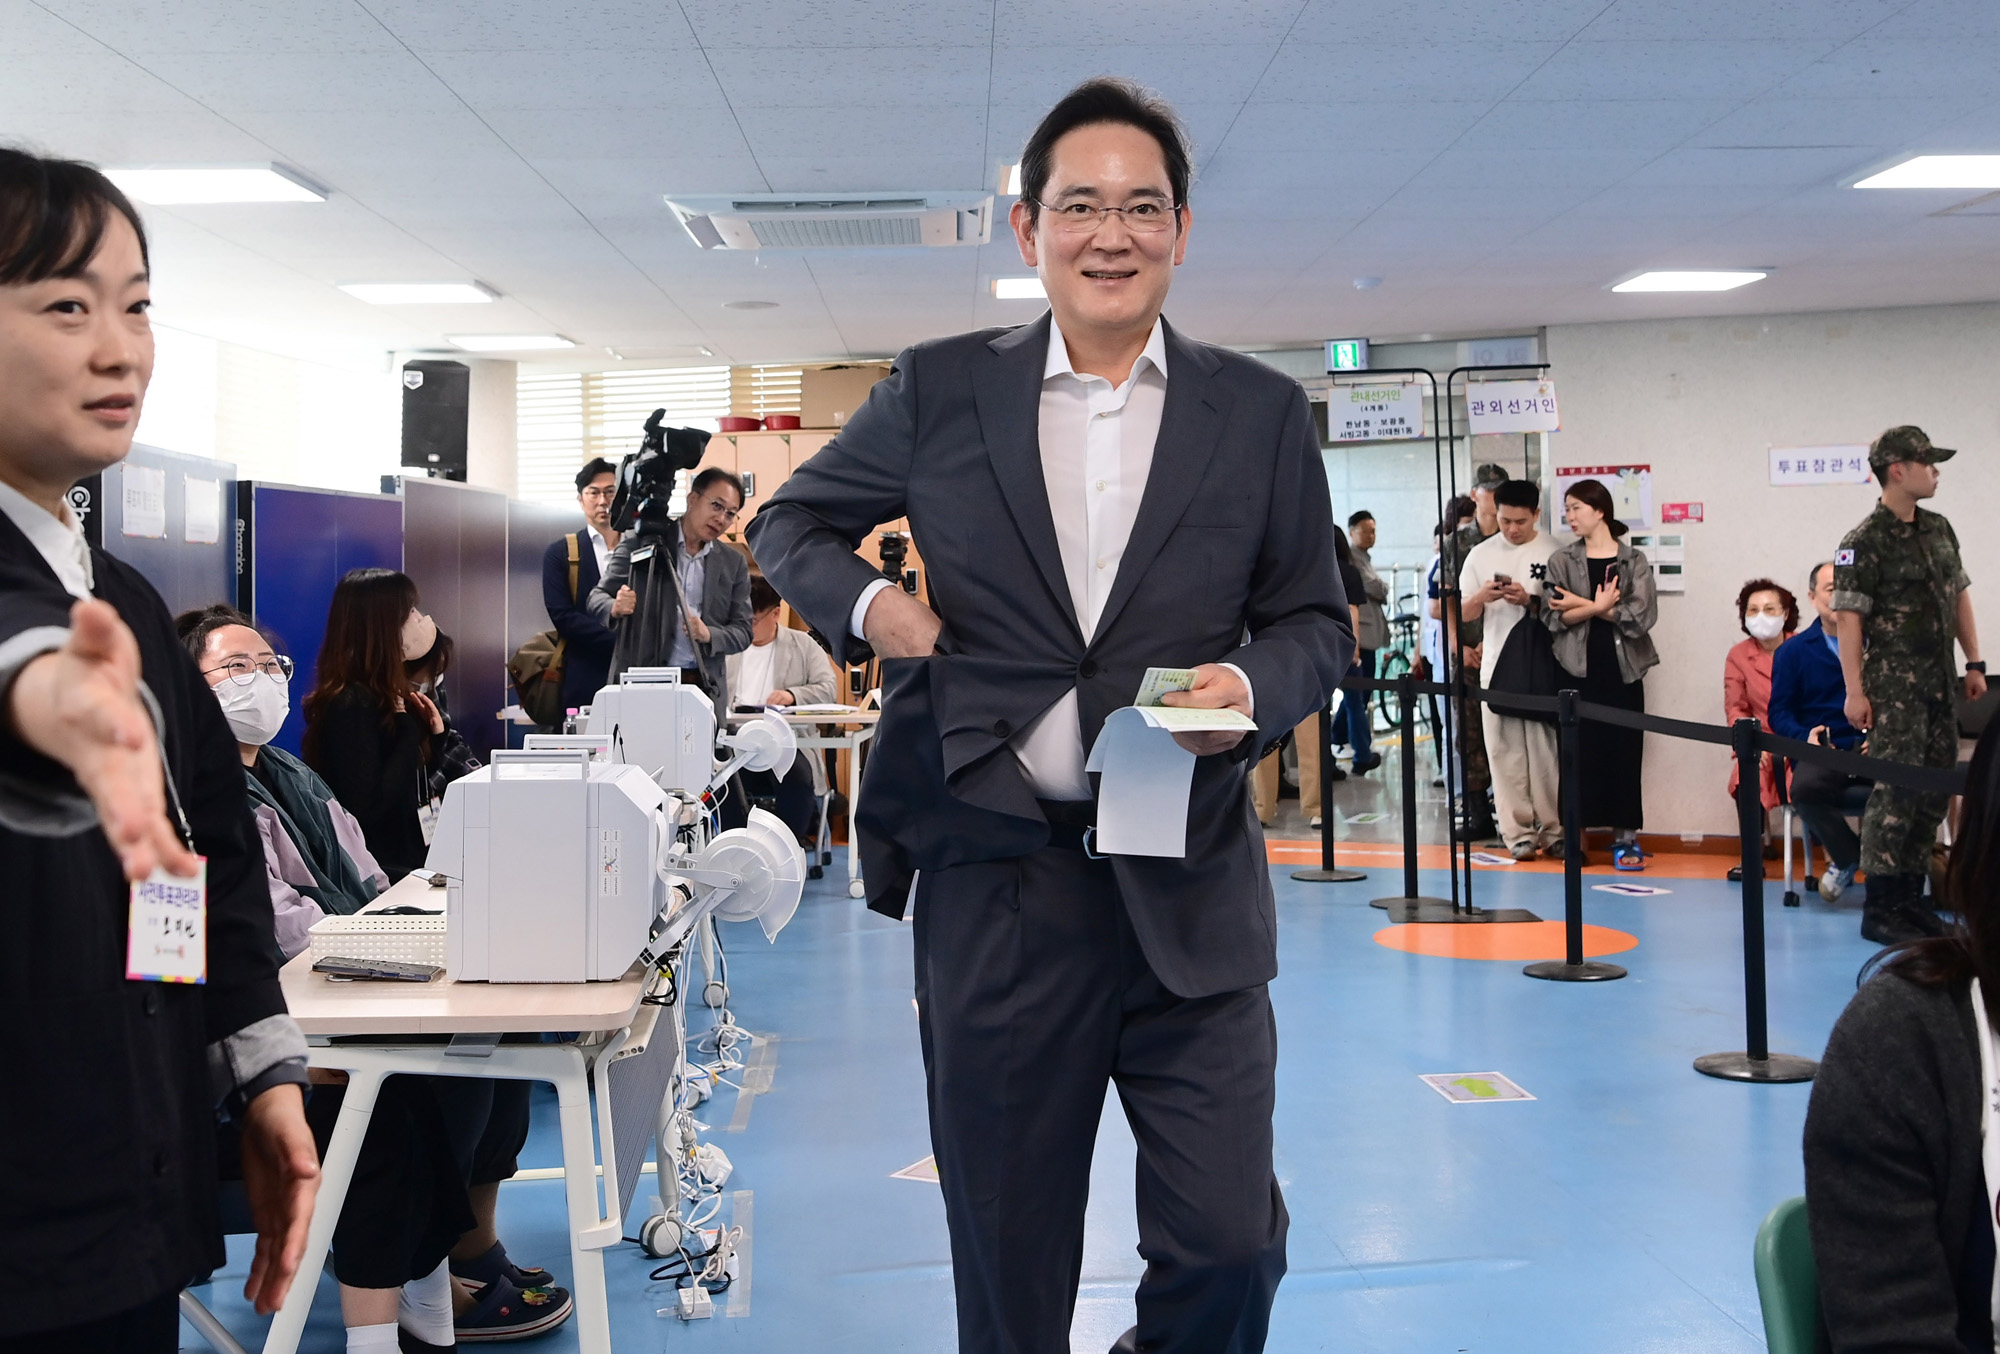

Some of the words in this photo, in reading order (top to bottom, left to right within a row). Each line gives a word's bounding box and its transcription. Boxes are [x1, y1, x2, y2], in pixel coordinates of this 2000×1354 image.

[1350, 389, 1401, 403] 관내선거인
[1471, 397, 1555, 416] 관외선거인
[1345, 419, 1371, 429] 한남동
[1778, 456, 1862, 474] 투표참관석
